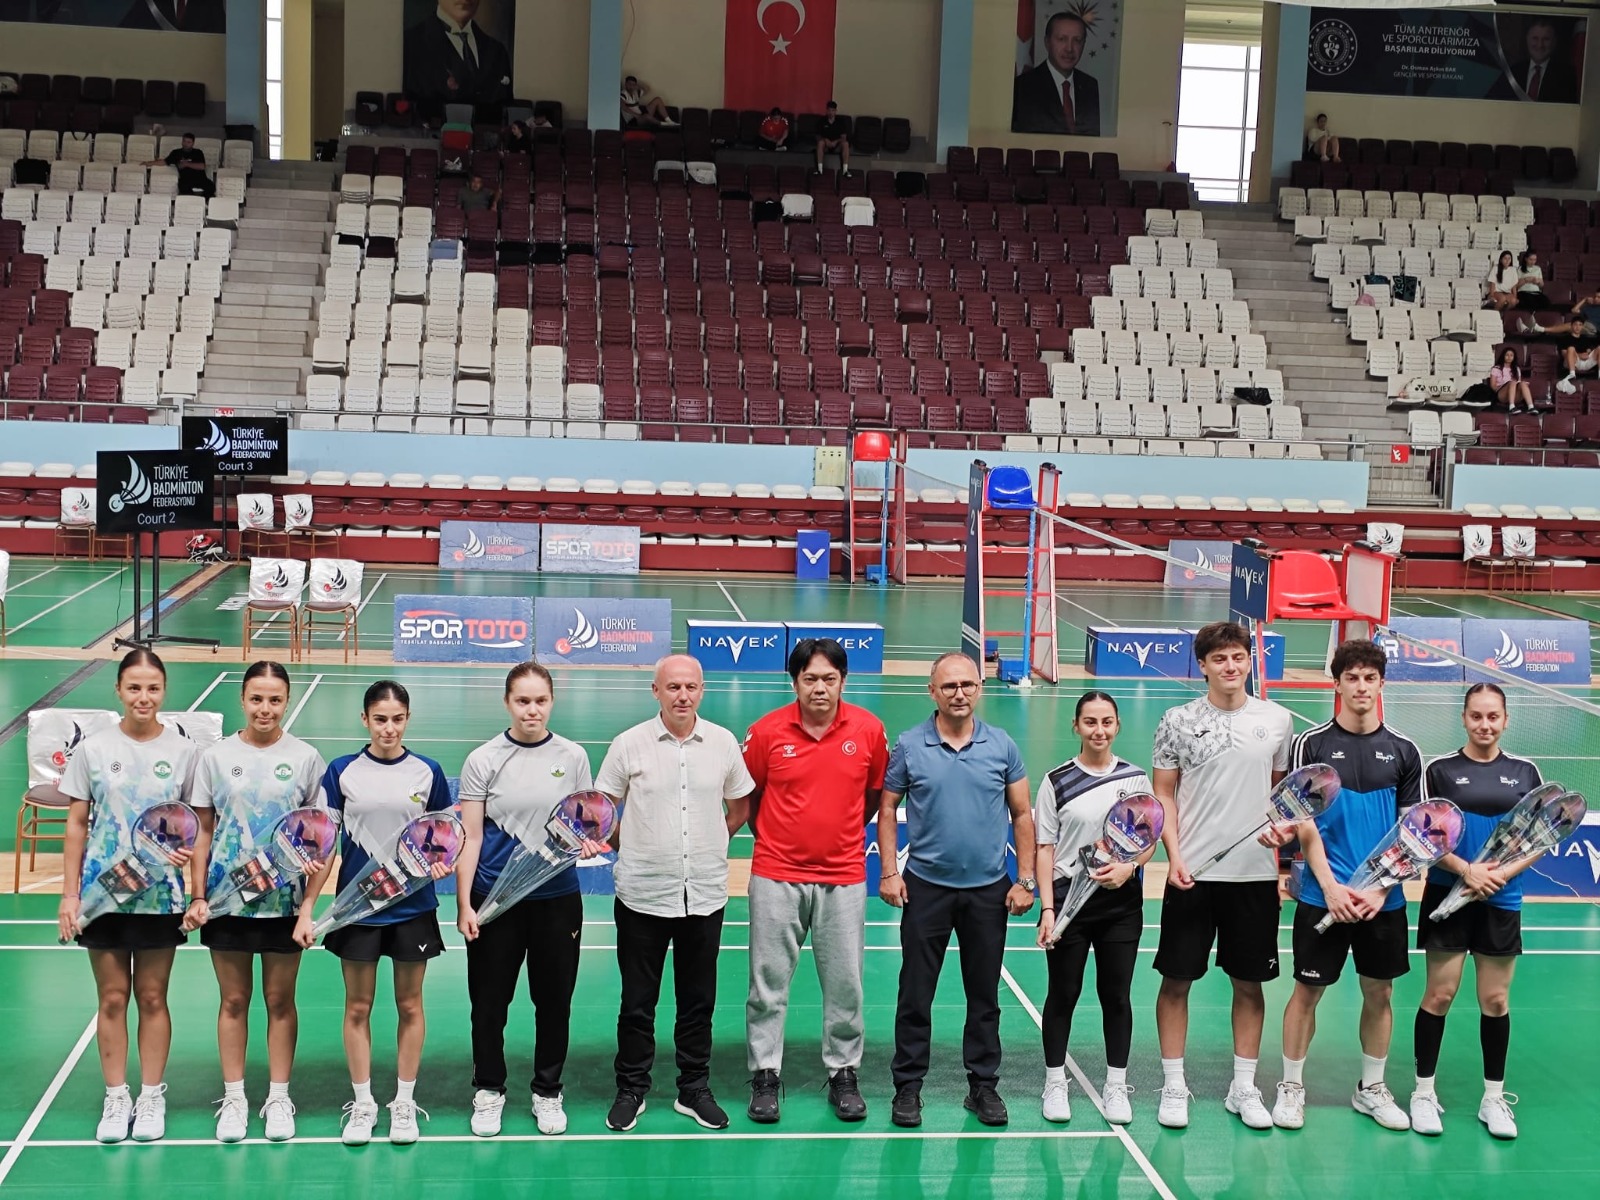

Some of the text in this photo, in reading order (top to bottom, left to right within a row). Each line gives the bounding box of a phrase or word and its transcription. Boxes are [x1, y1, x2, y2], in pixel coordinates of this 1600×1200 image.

[1394, 24, 1470, 37] TÜM ANTRENÖR
[1382, 34, 1480, 47] VE SPORCULARIMIZA
[1385, 45, 1476, 56] BAŞARILAR DİLİYORUM
[232, 427, 264, 439] TÜRKİYE
[232, 451, 271, 459] FEDERASYONU
[153, 464, 189, 480] TÜRKİYE
[218, 461, 253, 471] Court 3
[153, 496, 196, 507] FEDERASYONU
[137, 511, 176, 525] Court 2
[970, 509, 976, 535] 2
[1235, 565, 1264, 600] NAVEK
[601, 616, 636, 630] TÜRKİYE
[601, 644, 637, 652] FEDERATION
[700, 635, 778, 664] NAVEK
[1525, 638, 1559, 651] TÜRKİYE
[1107, 641, 1182, 669] NAVEK
[1526, 664, 1560, 672] FEDERATION
[411, 845, 431, 873] VICTOR
